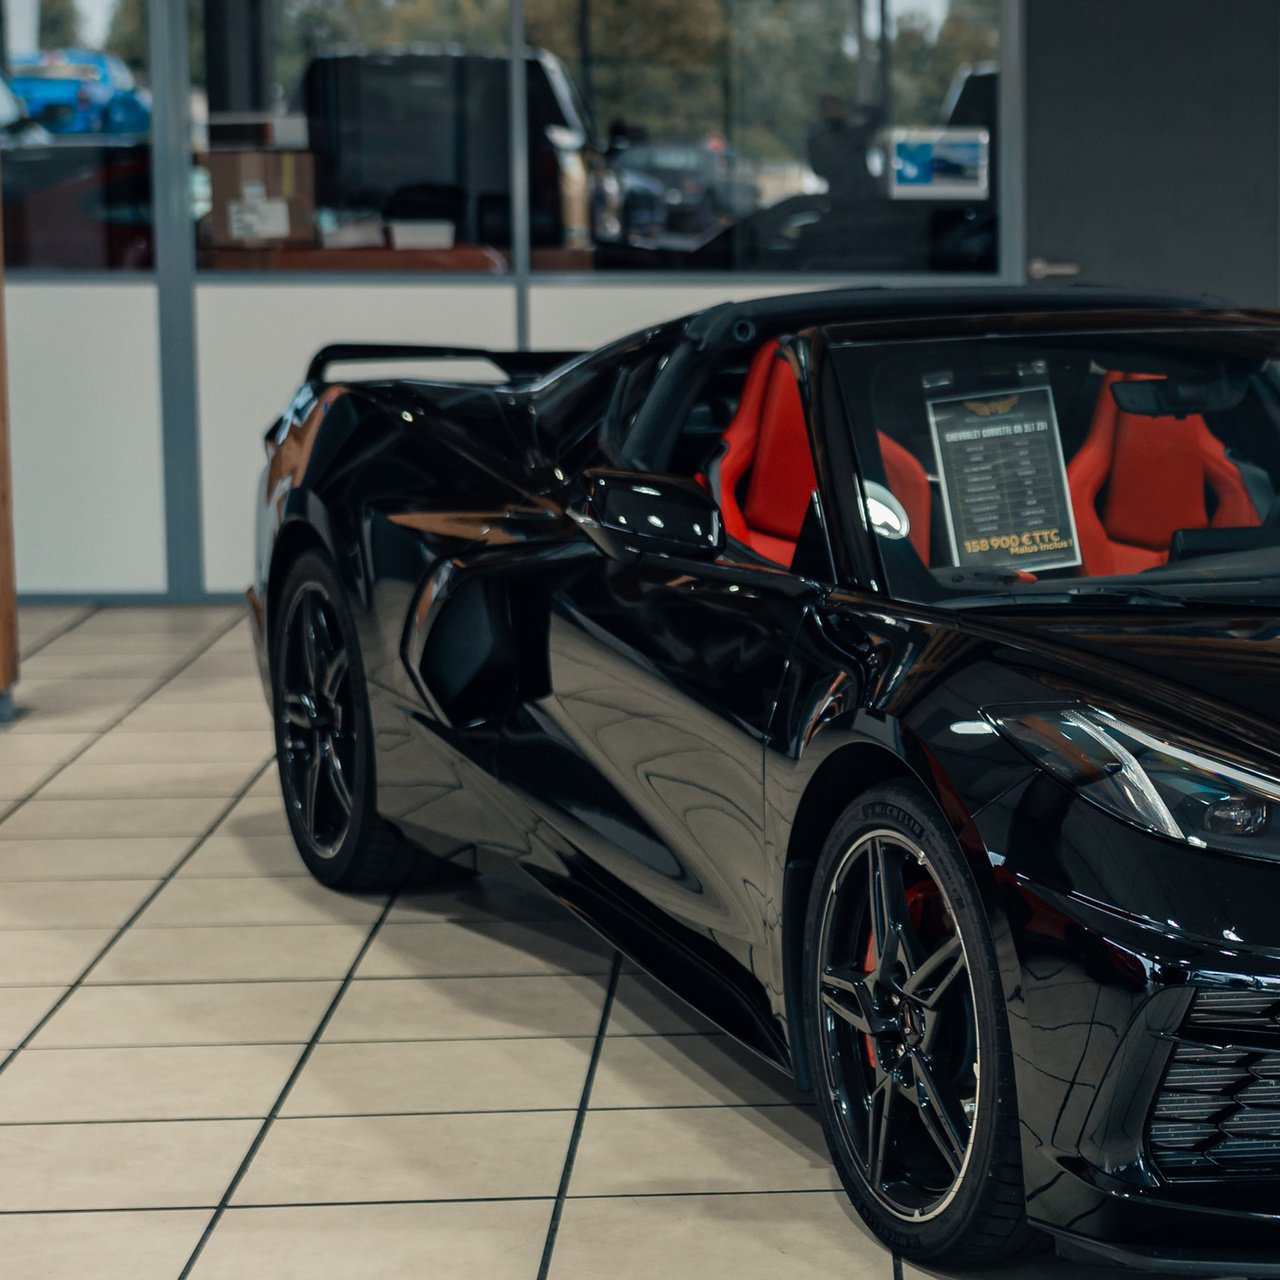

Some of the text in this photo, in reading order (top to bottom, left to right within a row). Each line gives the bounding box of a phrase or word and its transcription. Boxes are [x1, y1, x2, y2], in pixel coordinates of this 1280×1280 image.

[982, 425, 1013, 438] CORVETTE
[964, 538, 990, 553] 158
[990, 534, 1020, 549] 900
[1032, 528, 1060, 544] TTC
[1009, 544, 1038, 555] Malus
[874, 804, 922, 835] MICHELIN
